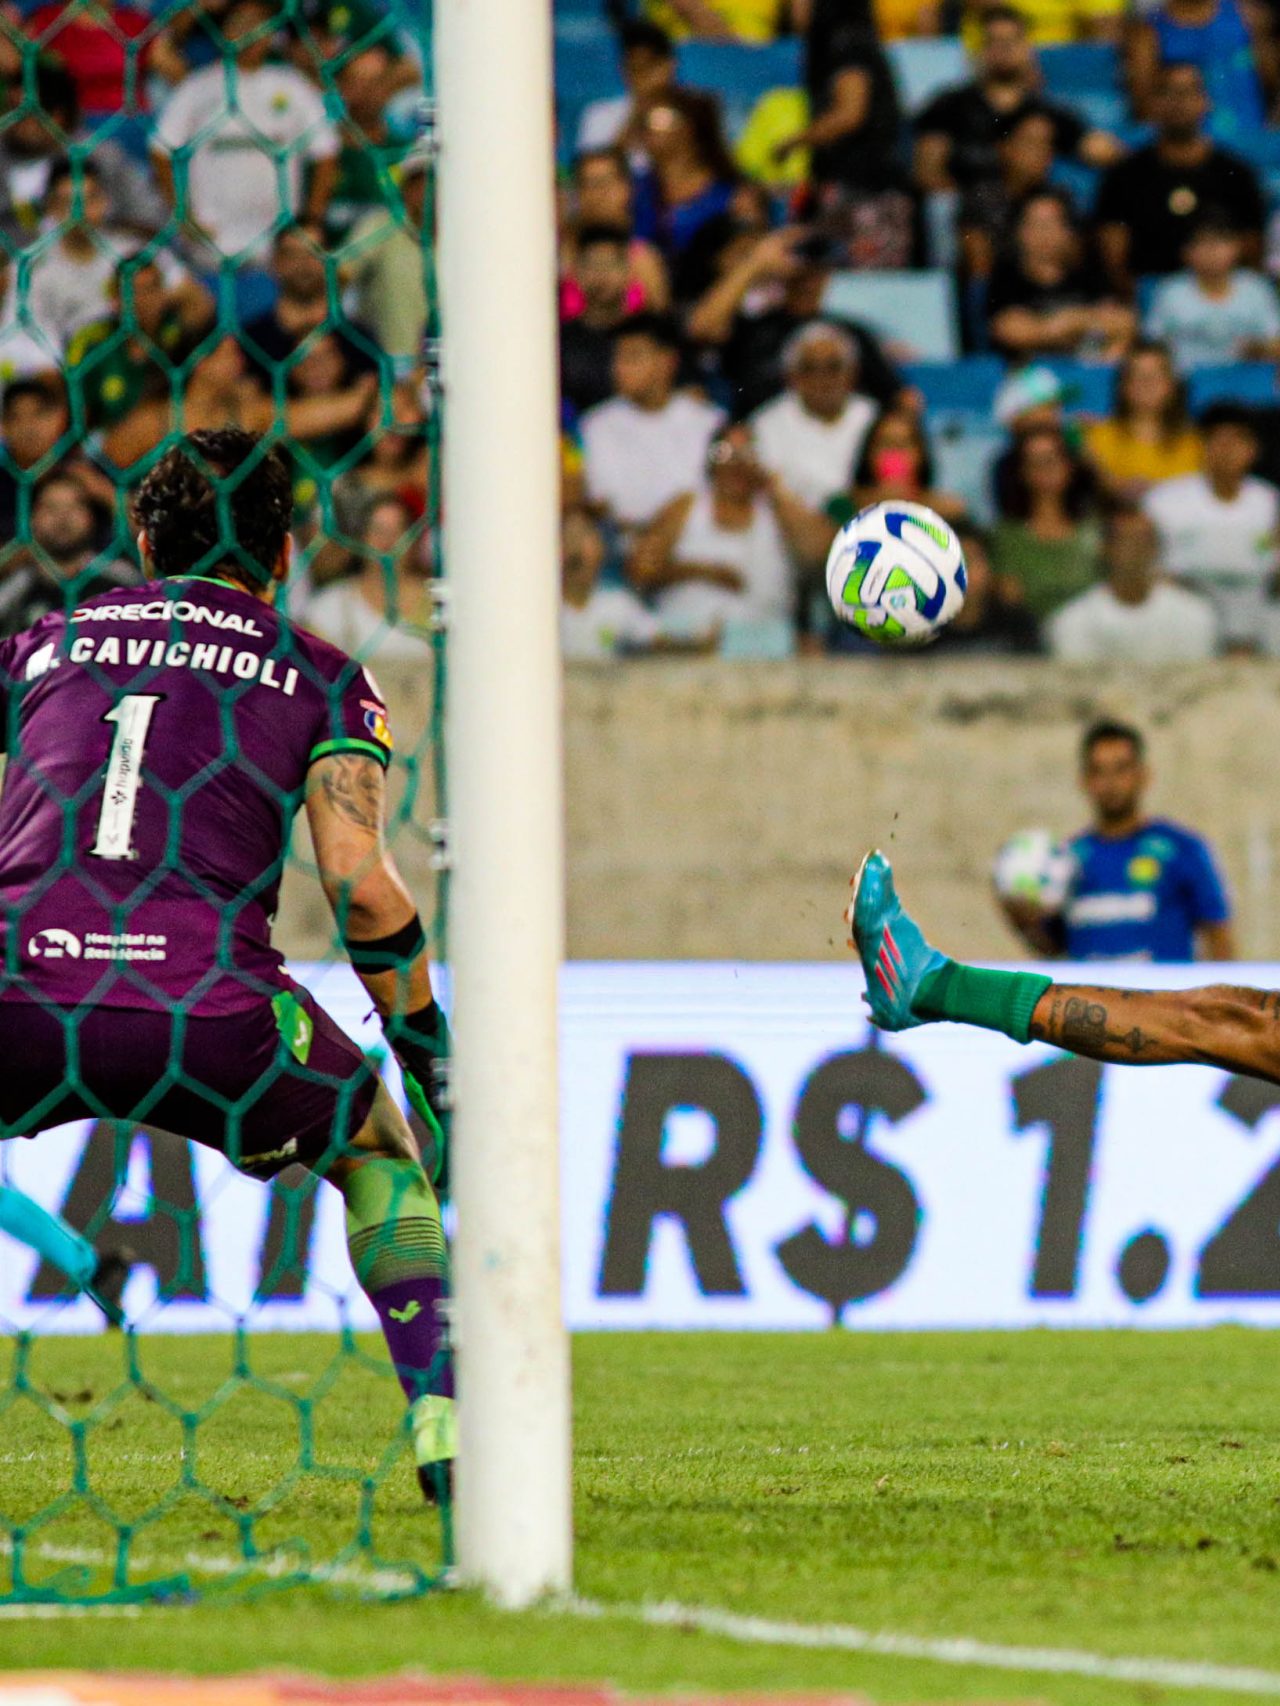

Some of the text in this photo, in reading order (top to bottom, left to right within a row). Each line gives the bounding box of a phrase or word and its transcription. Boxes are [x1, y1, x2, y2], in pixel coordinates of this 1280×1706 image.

[69, 600, 264, 637] DIRECIONAL
[69, 637, 299, 696] CAVICHIOLI
[89, 694, 162, 860] 1
[597, 1030, 930, 1328] R$
